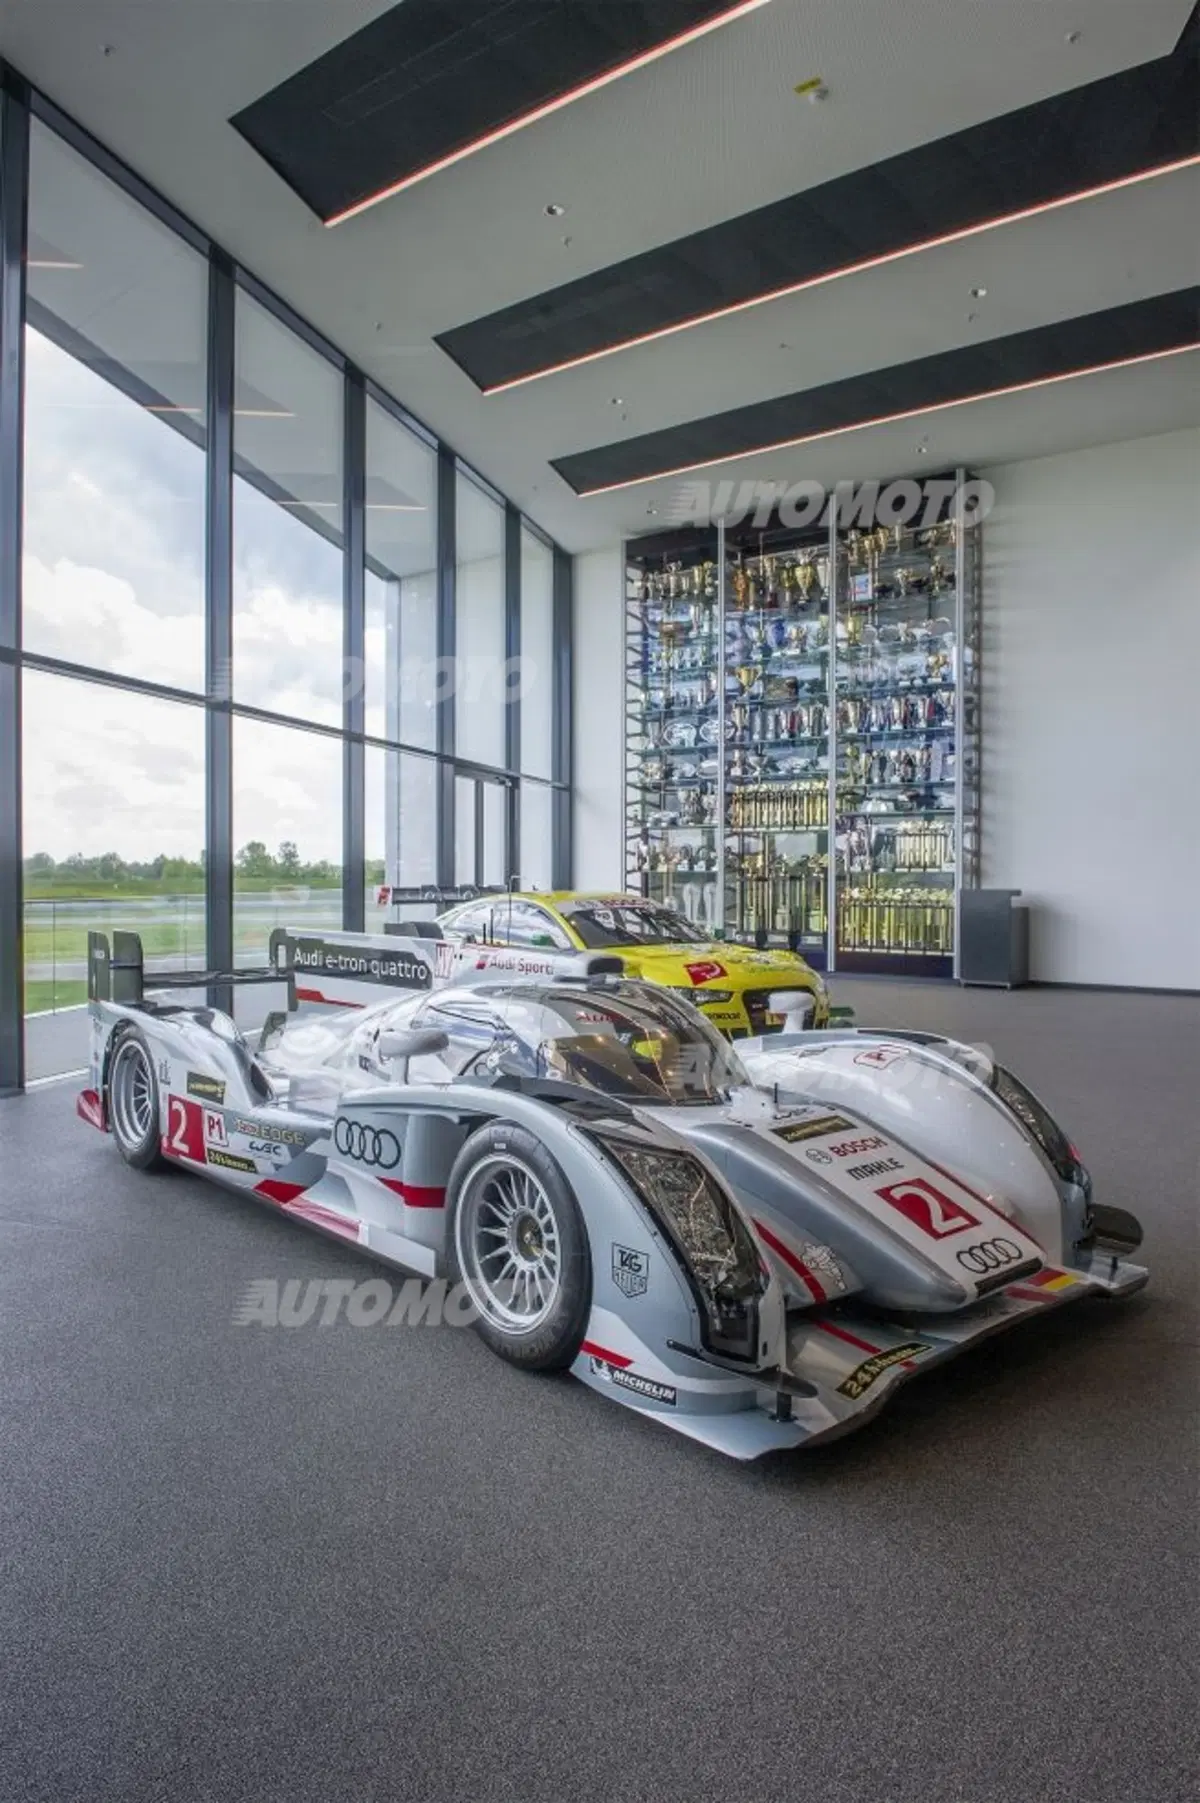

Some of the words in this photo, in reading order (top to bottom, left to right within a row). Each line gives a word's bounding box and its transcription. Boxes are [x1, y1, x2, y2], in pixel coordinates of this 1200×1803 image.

[293, 947, 322, 966] Audi
[325, 954, 367, 972] e-tron
[371, 959, 427, 980] quattro
[172, 1101, 189, 1154] 2
[208, 1115, 224, 1141] P1
[261, 1125, 304, 1145] EDGE
[828, 1135, 888, 1157] BOSCH
[846, 1157, 904, 1181] MAHLE
[889, 1184, 972, 1234] 2
[618, 1249, 642, 1272] TAG
[613, 1371, 675, 1400] MICHELIN
